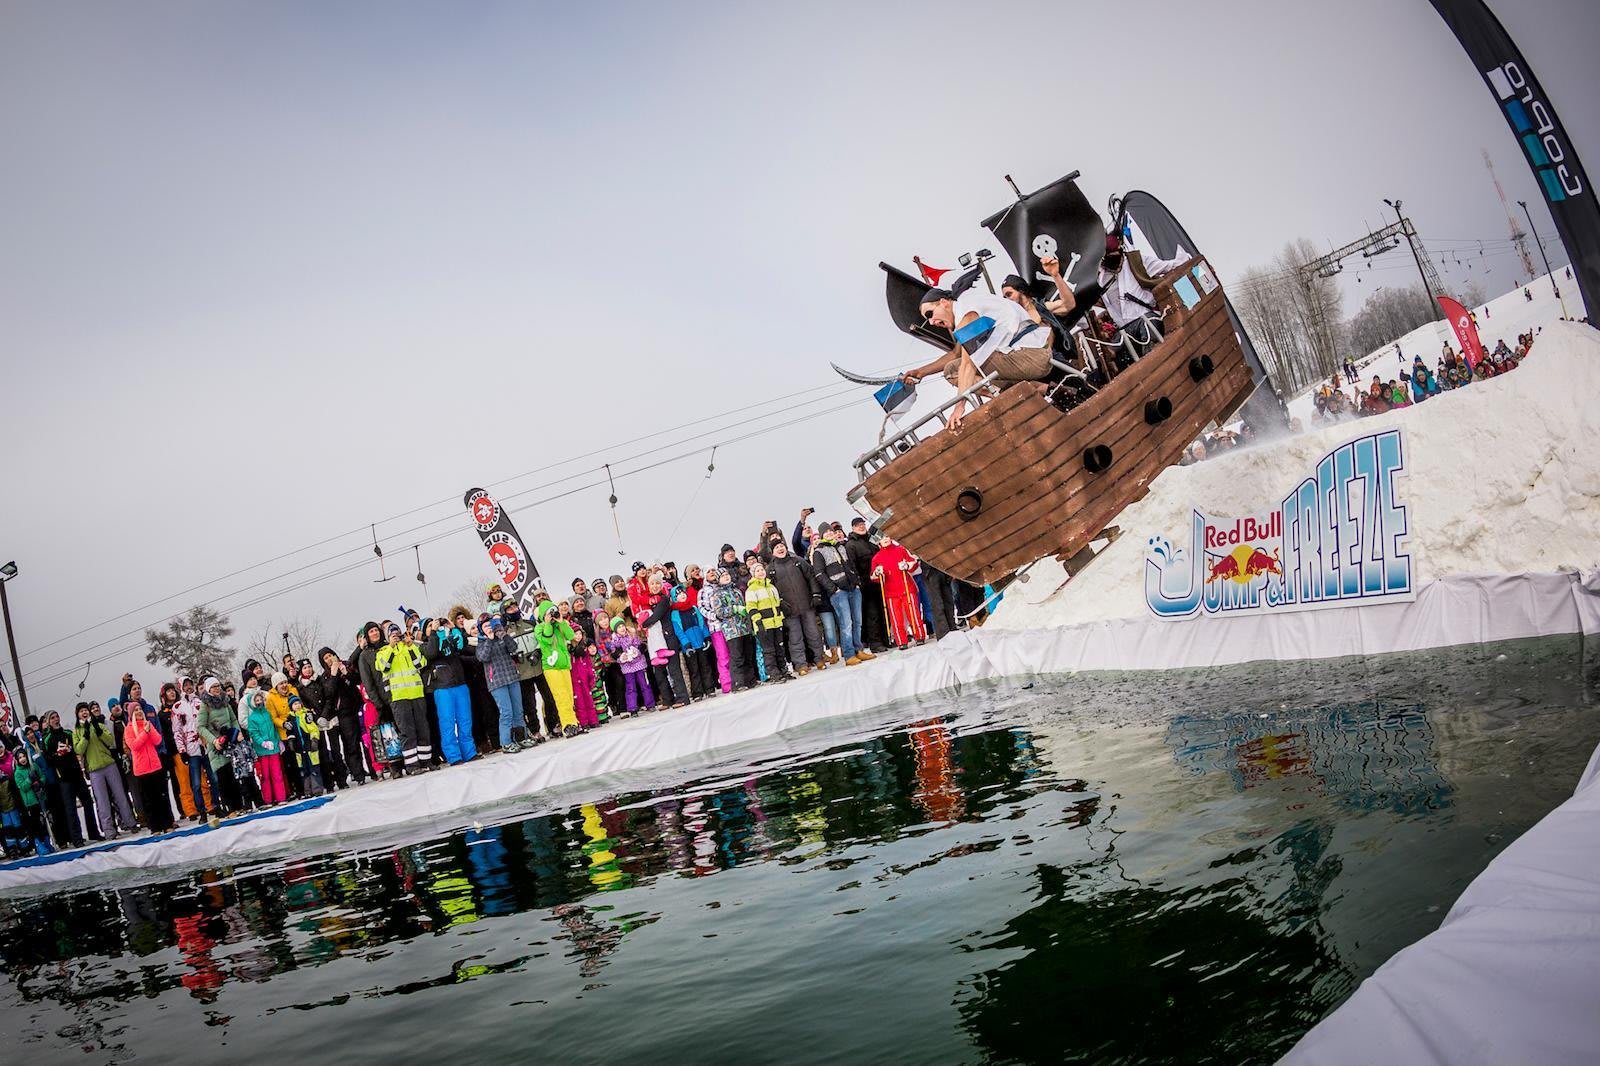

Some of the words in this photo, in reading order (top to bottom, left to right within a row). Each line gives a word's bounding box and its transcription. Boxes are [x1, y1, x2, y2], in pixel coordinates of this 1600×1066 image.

[1205, 518, 1240, 549] Red
[1244, 510, 1281, 542] Bull
[1282, 430, 1411, 602] FREEZE
